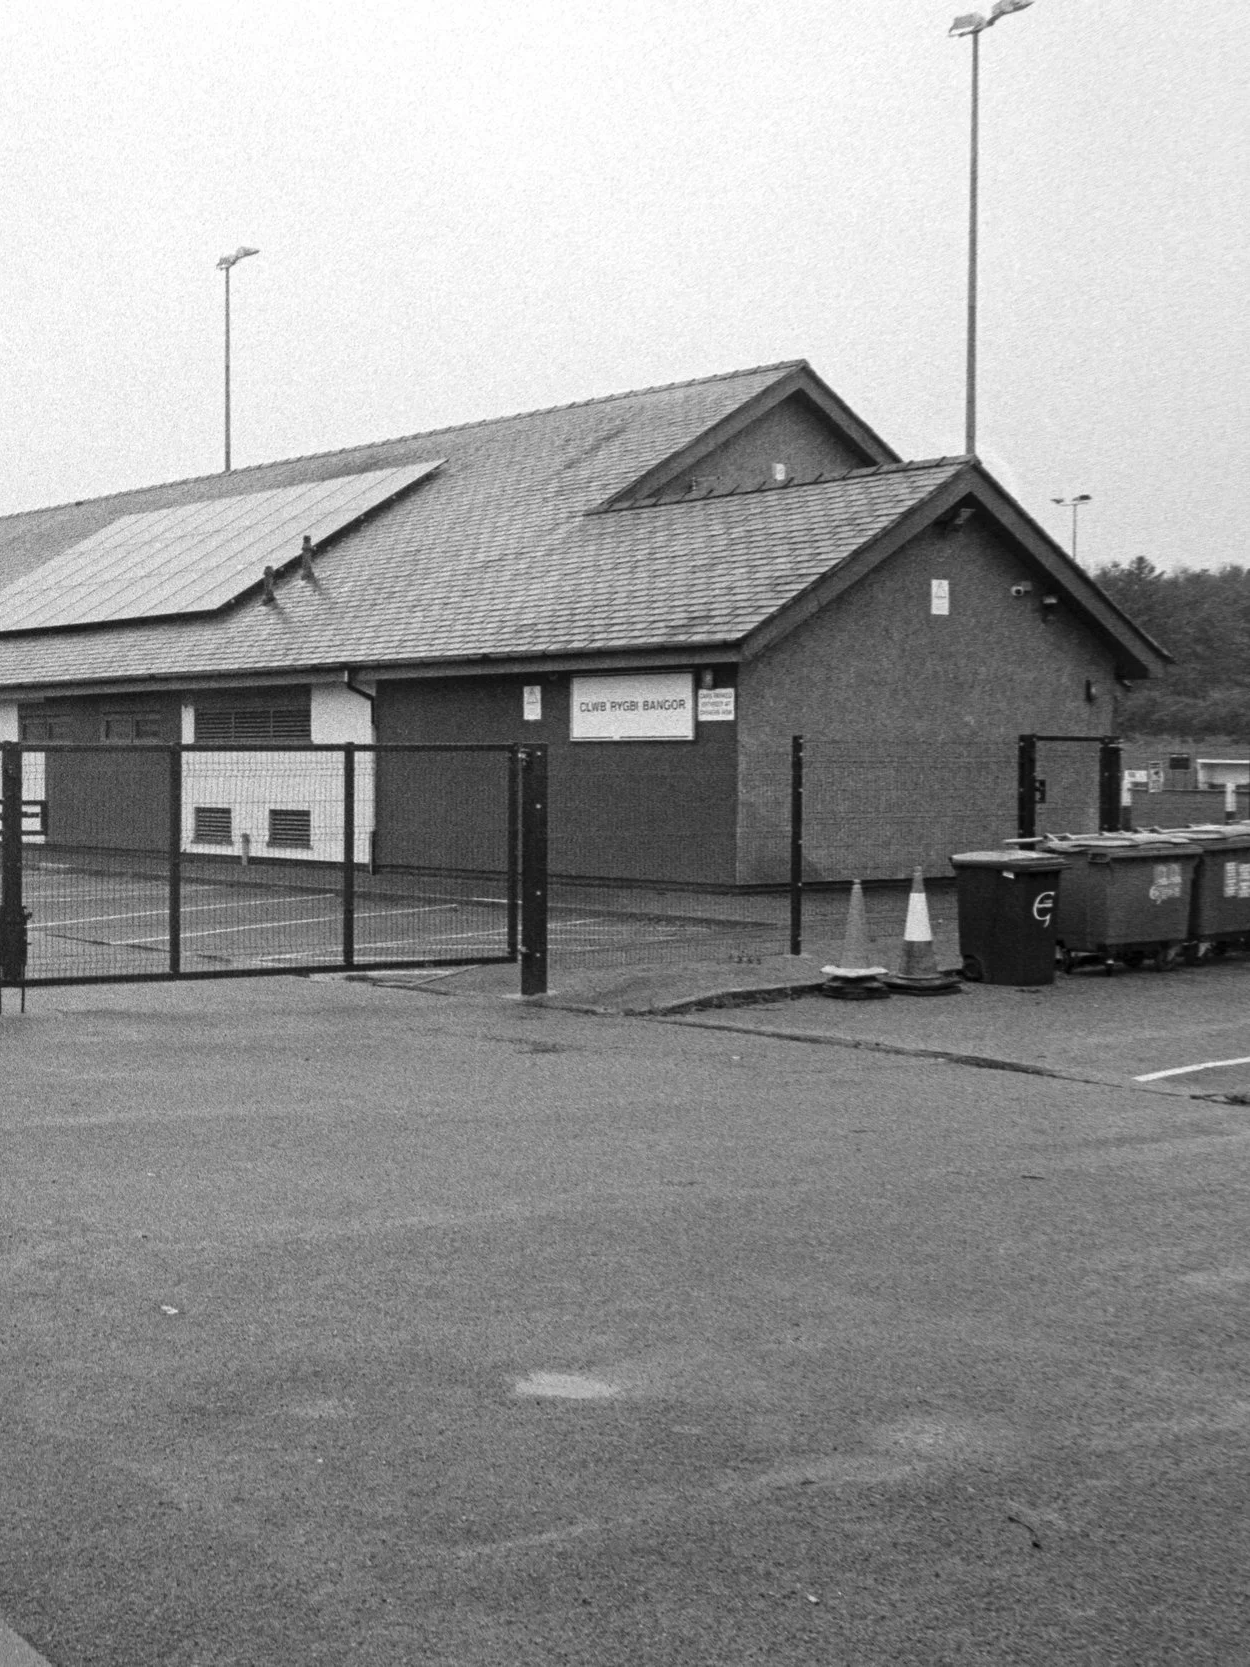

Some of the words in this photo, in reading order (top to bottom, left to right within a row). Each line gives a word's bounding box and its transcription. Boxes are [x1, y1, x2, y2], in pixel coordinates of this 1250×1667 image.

[579, 701, 607, 713] CLWB
[610, 700, 639, 712] RYGBI
[642, 698, 687, 711] BANGOR
